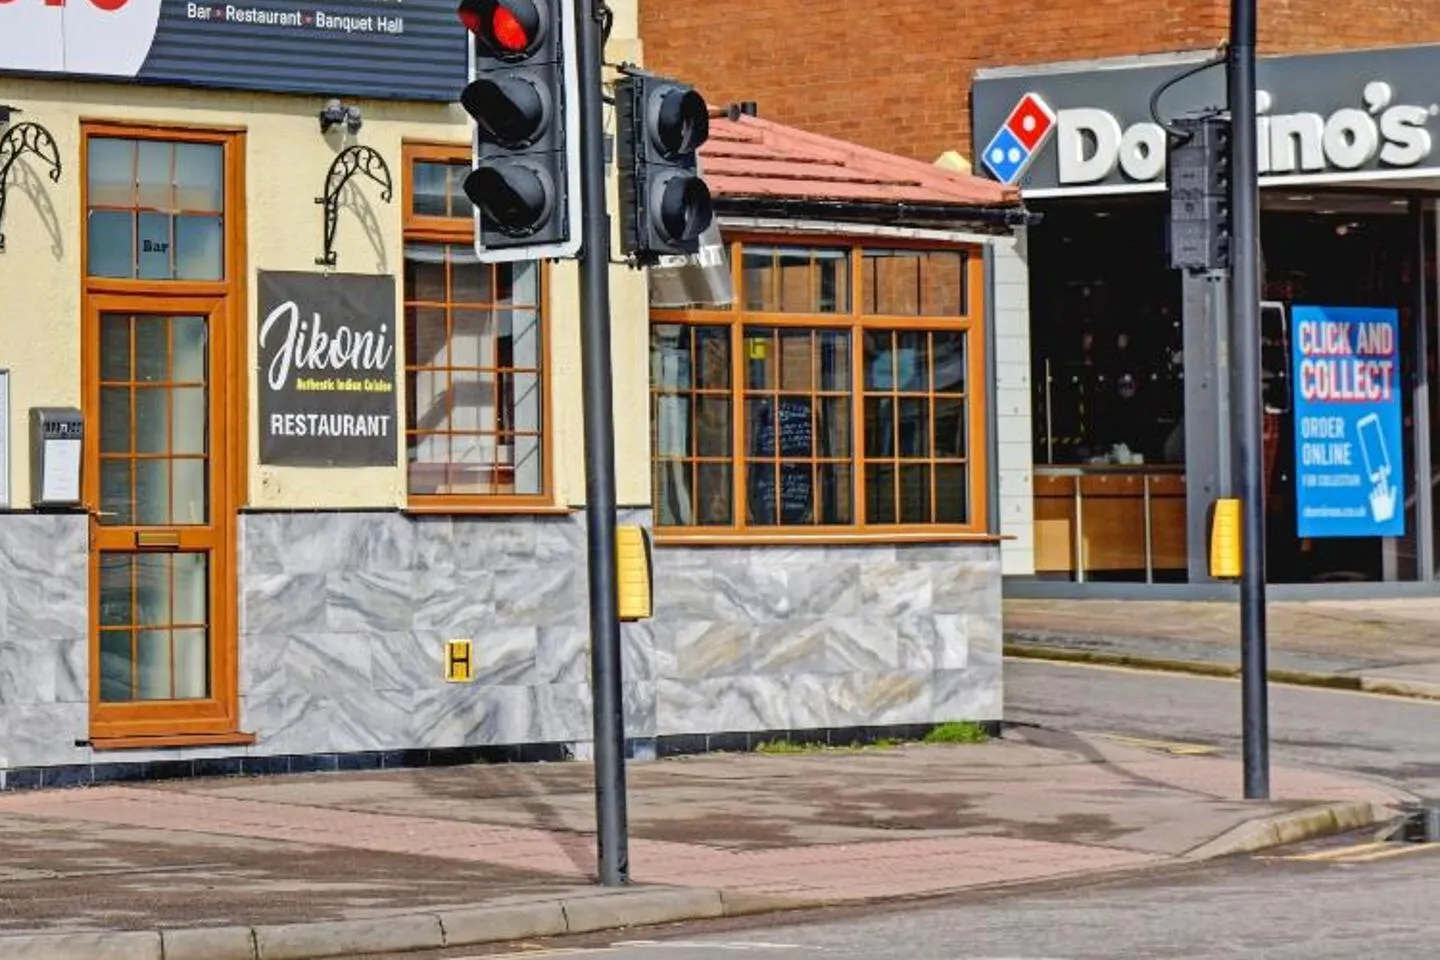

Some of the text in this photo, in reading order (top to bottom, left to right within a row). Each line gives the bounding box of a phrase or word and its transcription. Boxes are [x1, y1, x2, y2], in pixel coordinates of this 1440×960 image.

[187, 2, 404, 33] Bar Restaurant Banquet Hall
[1058, 81, 1432, 184] Doino's
[260, 300, 393, 391] Jikoni
[1299, 320, 1394, 357] CLICK AND
[1299, 359, 1394, 402] COLLECT
[271, 413, 391, 437] RESTAURANT
[1301, 416, 1345, 440] ORDER
[1302, 442, 1353, 466] ONLINE
